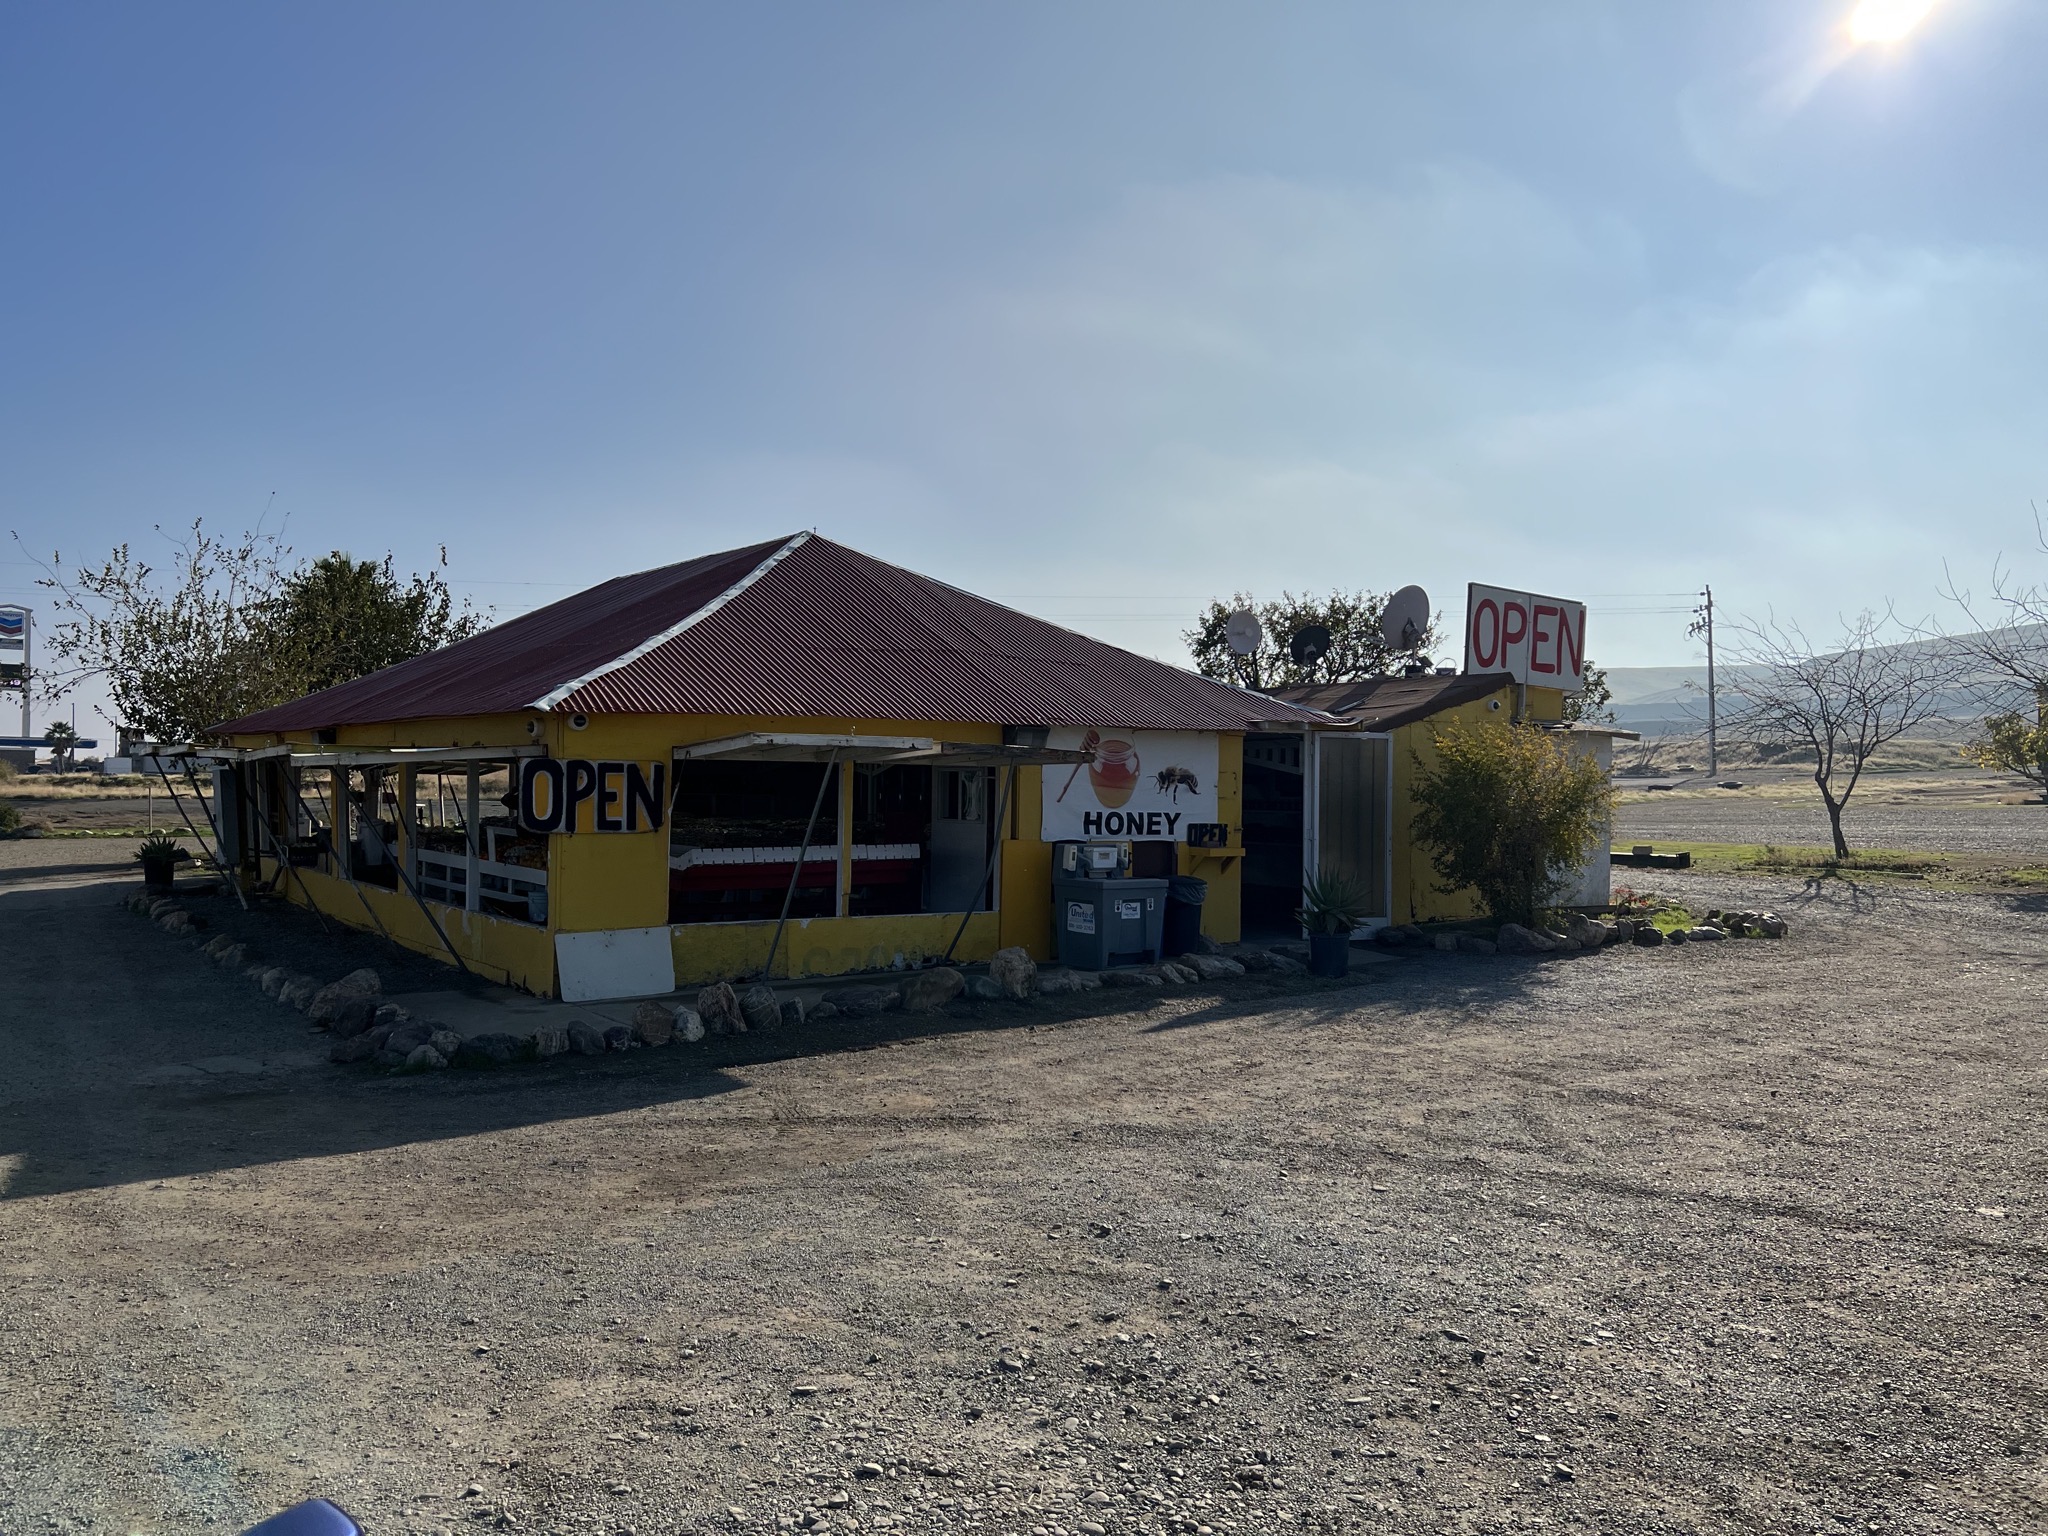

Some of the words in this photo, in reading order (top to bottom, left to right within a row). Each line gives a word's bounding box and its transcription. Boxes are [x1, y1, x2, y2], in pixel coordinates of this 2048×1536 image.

[1473, 599, 1584, 676] OPEN
[522, 759, 665, 831] OPEN
[1083, 811, 1181, 835] HONEY
[1188, 824, 1228, 847] OPEN
[1071, 908, 1094, 919] United
